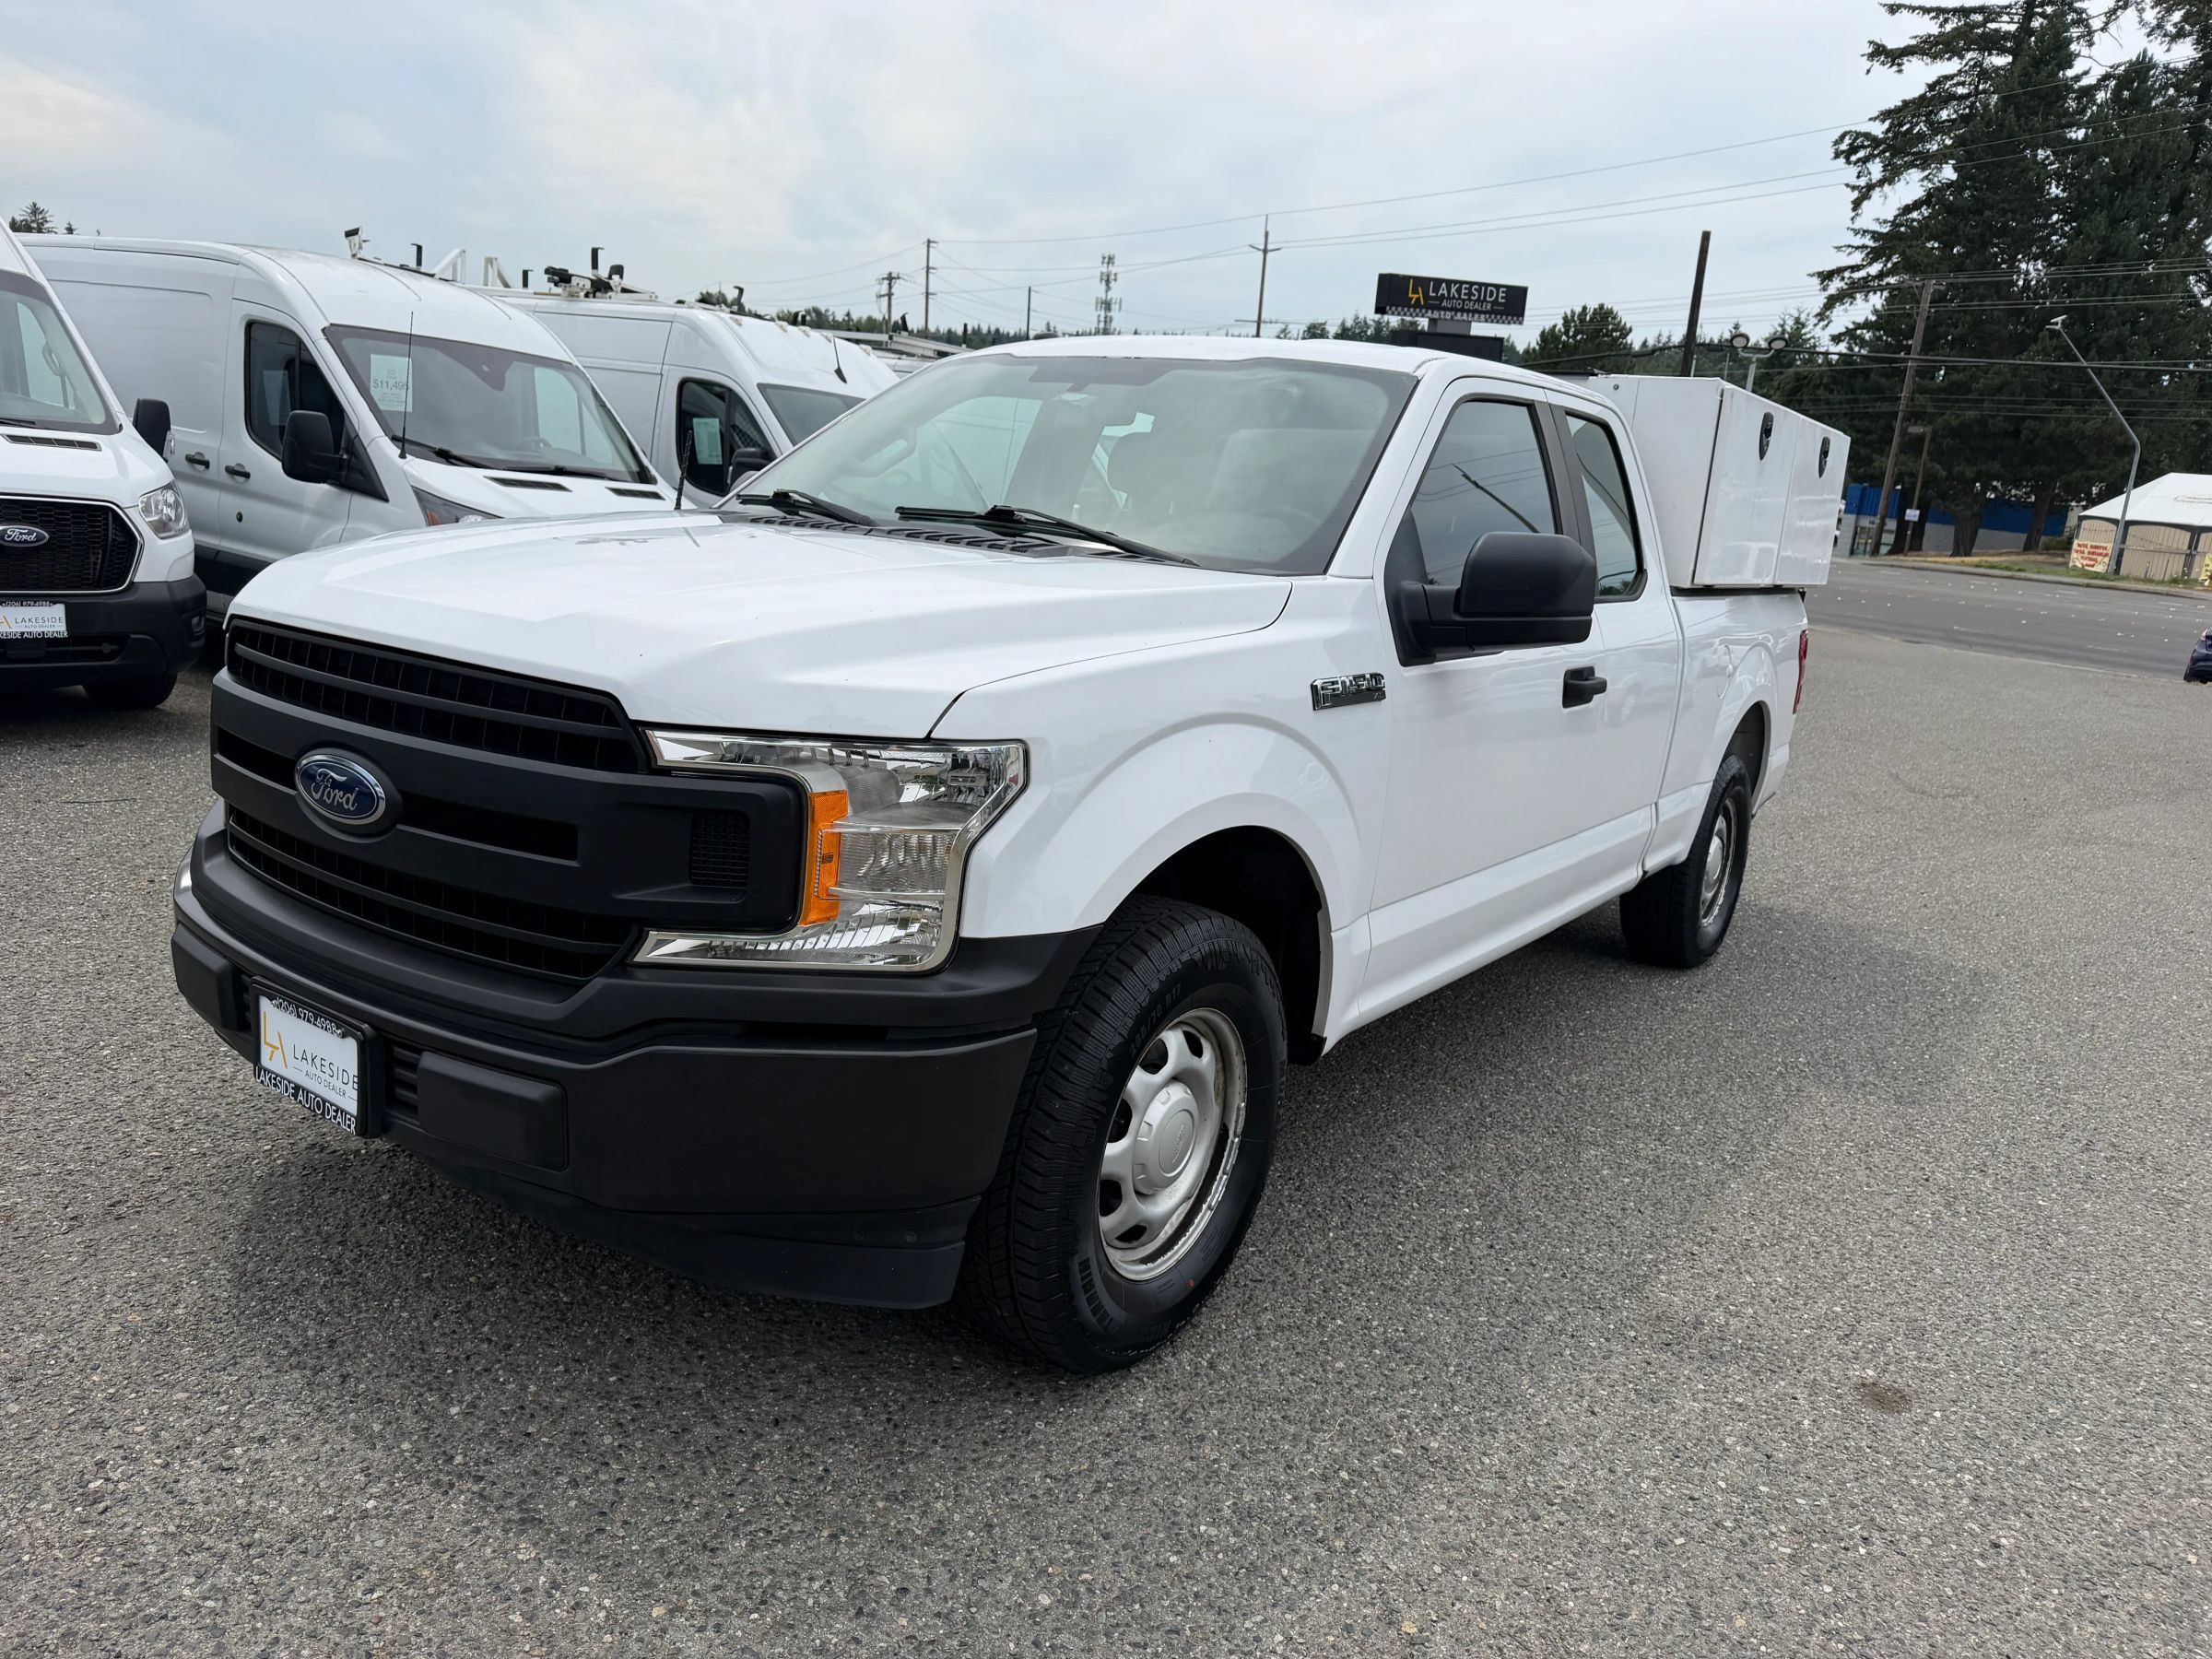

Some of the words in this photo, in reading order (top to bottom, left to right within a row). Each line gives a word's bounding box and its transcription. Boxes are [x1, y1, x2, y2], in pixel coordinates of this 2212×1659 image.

[1430, 281, 1507, 302] LAKESIDE
[1441, 300, 1463, 309] AUTO
[1464, 300, 1491, 311] DEALER
[5, 528, 37, 542] Ford
[311, 768, 359, 811] Ford
[276, 997, 297, 1018] (206)
[298, 1008, 337, 1036] 979-4988
[293, 1043, 359, 1091] LAKESIDE
[255, 1065, 295, 1100] LAKESIDE
[297, 1088, 323, 1114] AUTO
[325, 1101, 356, 1135] DEALER
[305, 1070, 323, 1085] AUTO
[324, 1078, 347, 1099] DEALER
